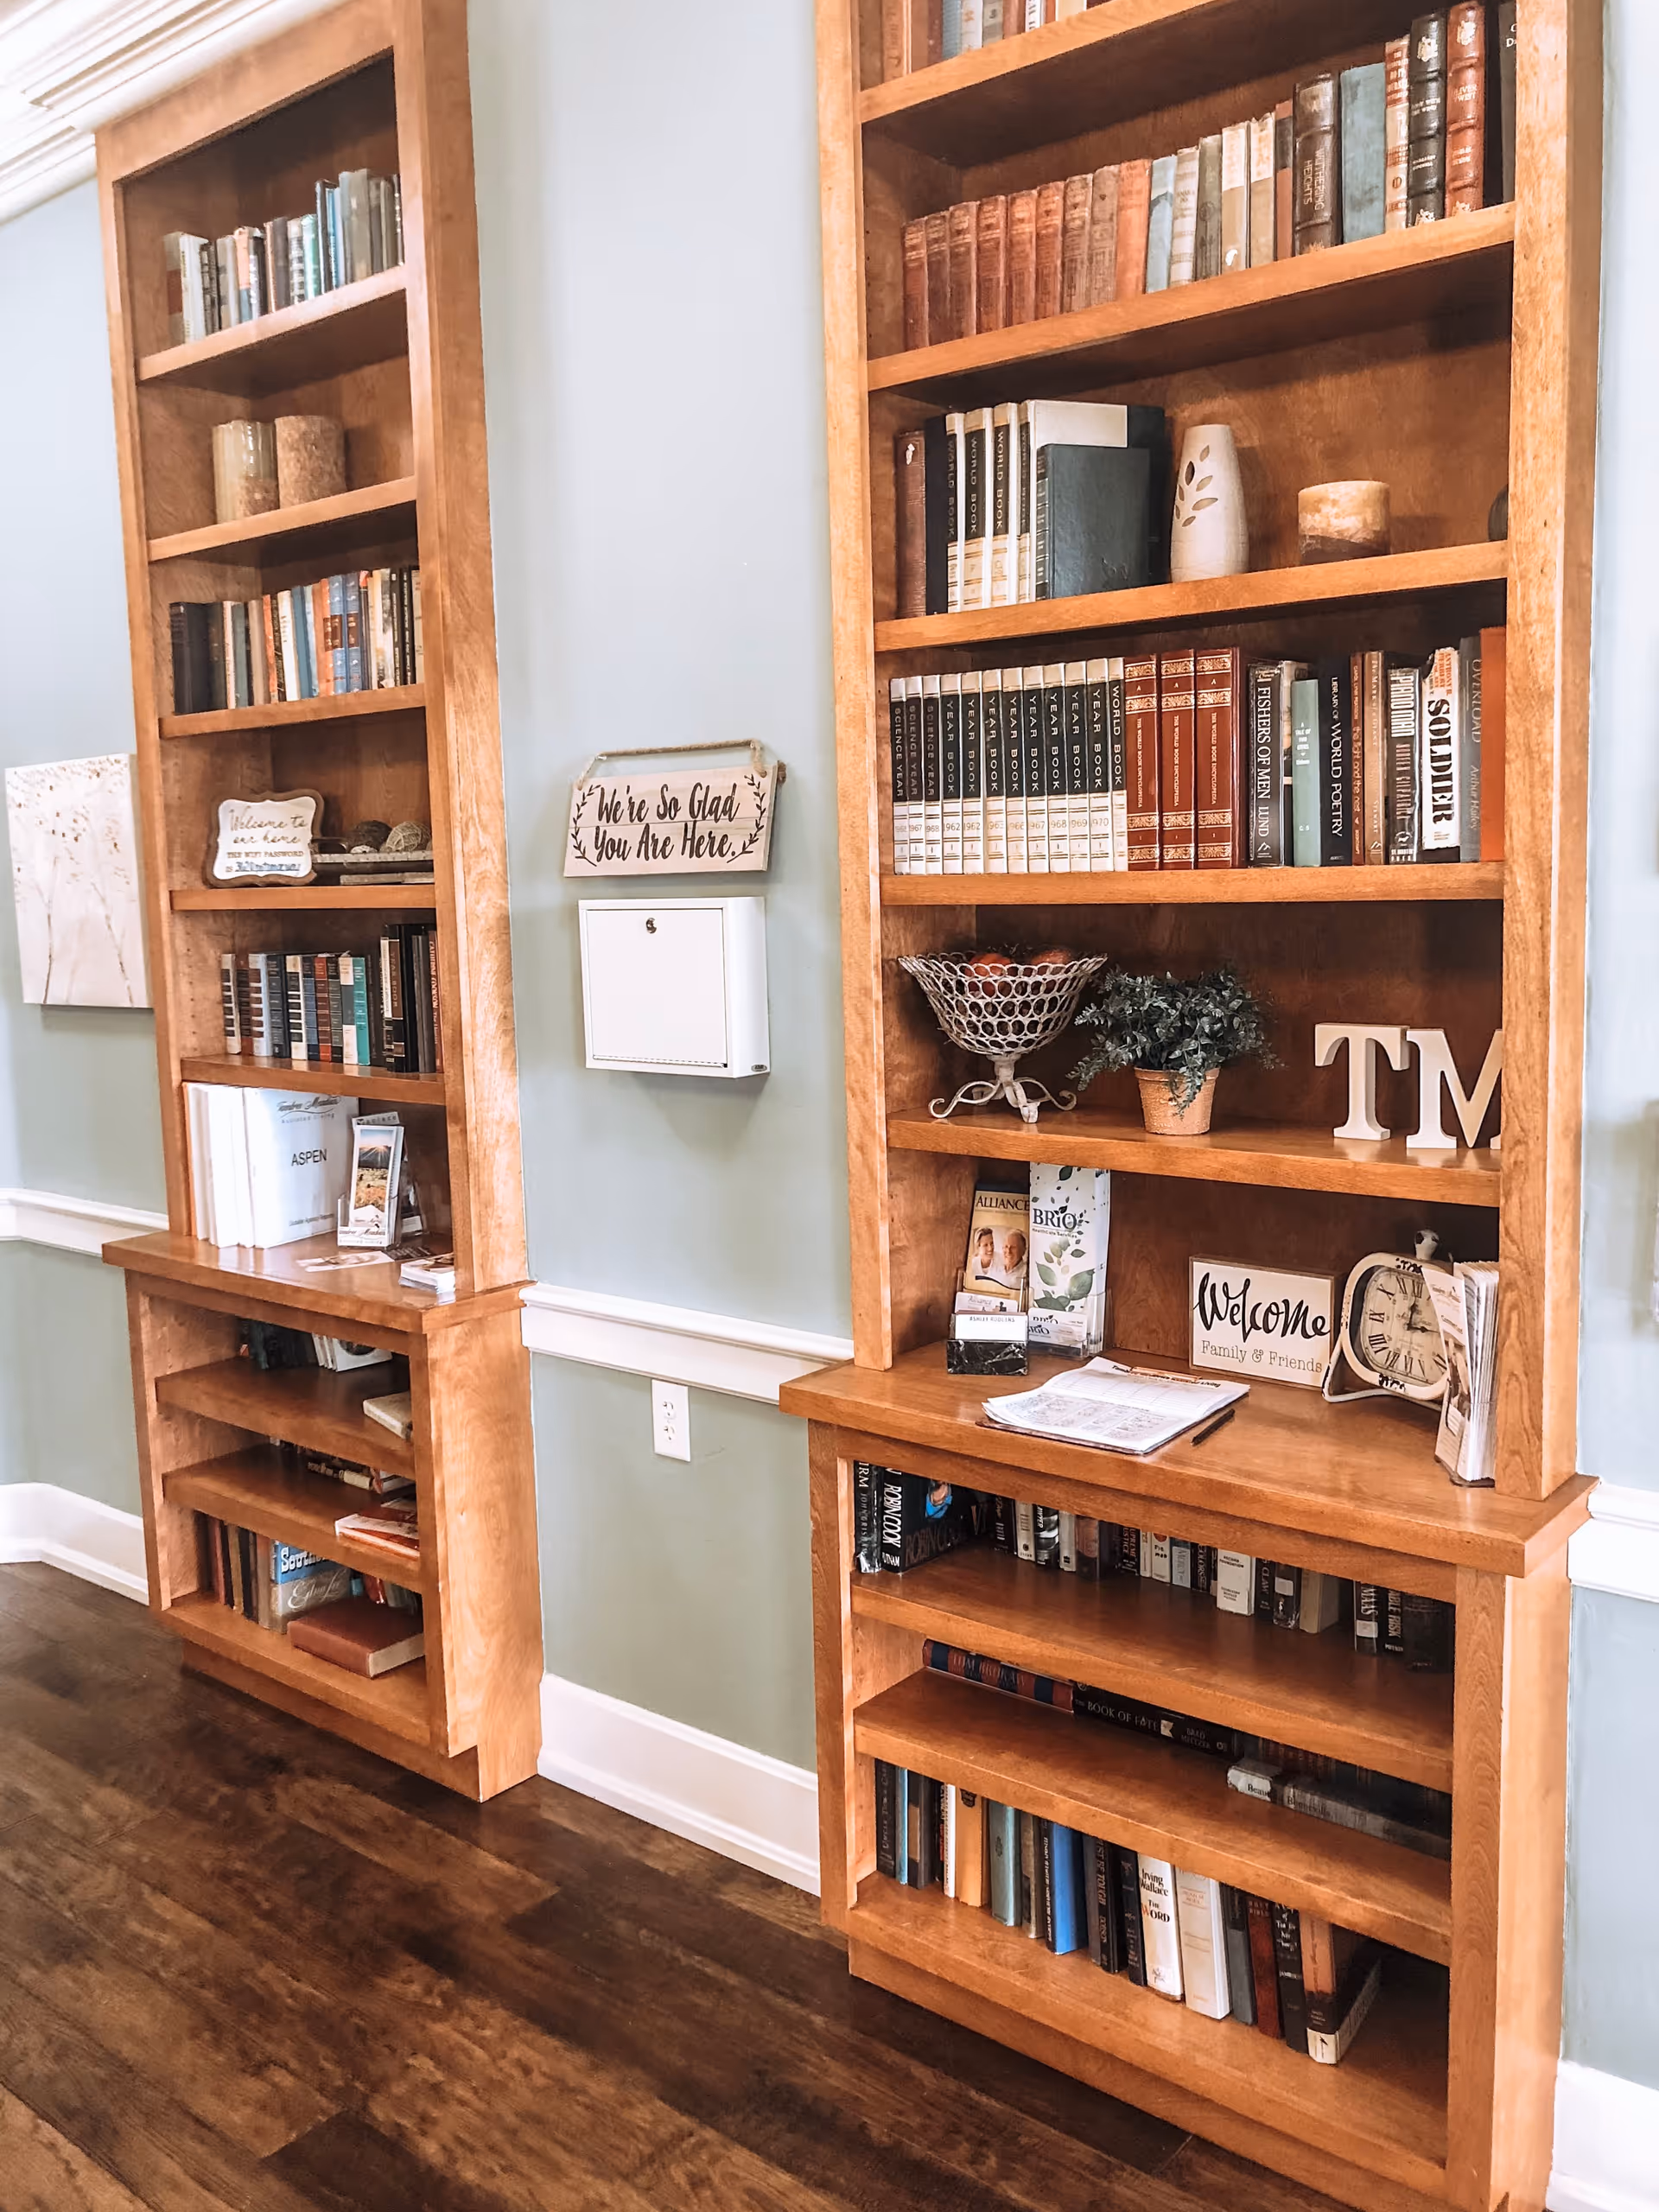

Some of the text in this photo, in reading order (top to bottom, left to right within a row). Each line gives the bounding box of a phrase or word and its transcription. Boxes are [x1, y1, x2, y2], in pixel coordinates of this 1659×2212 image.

[1303, 159, 1313, 206] HEIGHTS
[1314, 148, 1325, 211] WUTHERING
[995, 430, 1004, 481] WORLD
[894, 707, 903, 760] SCIENCE
[926, 705, 935, 759] SCIENCE
[946, 700, 955, 742] YEAR
[1009, 696, 1018, 739] YEAR
[1112, 684, 1122, 785] WORLD BOOK
[1257, 686, 1271, 745] FISHERS
[1332, 709, 1338, 720] OF
[1352, 726, 1362, 740] the
[988, 696, 998, 791] YEAR BOOK
[1029, 695, 1039, 792] YEAR BOOK
[1050, 692, 1060, 790] YEAR BOOK
[1071, 690, 1081, 789] YEAR BOOK
[1092, 689, 1103, 788] YEAR BOOK
[1257, 746, 1271, 766] OF
[1331, 722, 1343, 779] WORLD
[1353, 761, 1362, 778] and
[1427, 698, 1455, 825] SOLDIER
[1470, 765, 1480, 799] Arthur
[597, 782, 740, 823] We're So Glad
[1257, 767, 1271, 799] MEN
[1353, 779, 1362, 794] the
[229, 805, 288, 831] Welcome
[943, 822, 960, 831] 1962
[963, 822, 981, 831] 1962
[1258, 806, 1269, 837] LUND
[1331, 783, 1343, 837] POETRY
[594, 821, 736, 862] You Are Here.
[291, 1148, 327, 1166] ASPEN
[976, 1196, 1030, 1211] ALLIANCE
[1193, 1272, 1331, 1343] Welcome
[1201, 1340, 1323, 1374] Family & Friends
[883, 1483, 902, 1548] ROBIN COOK
[1087, 1700, 1116, 1718] BOOK
[1117, 1711, 1132, 1723] OF
[1135, 1715, 1159, 1732] FATE
[1096, 1840, 1105, 1859] UST
[1096, 1873, 1107, 1906] TOUGH
[1140, 1878, 1169, 1897] Wallace
[1141, 1869, 1164, 1887] Irving
[1141, 1902, 1171, 1923] WORD
